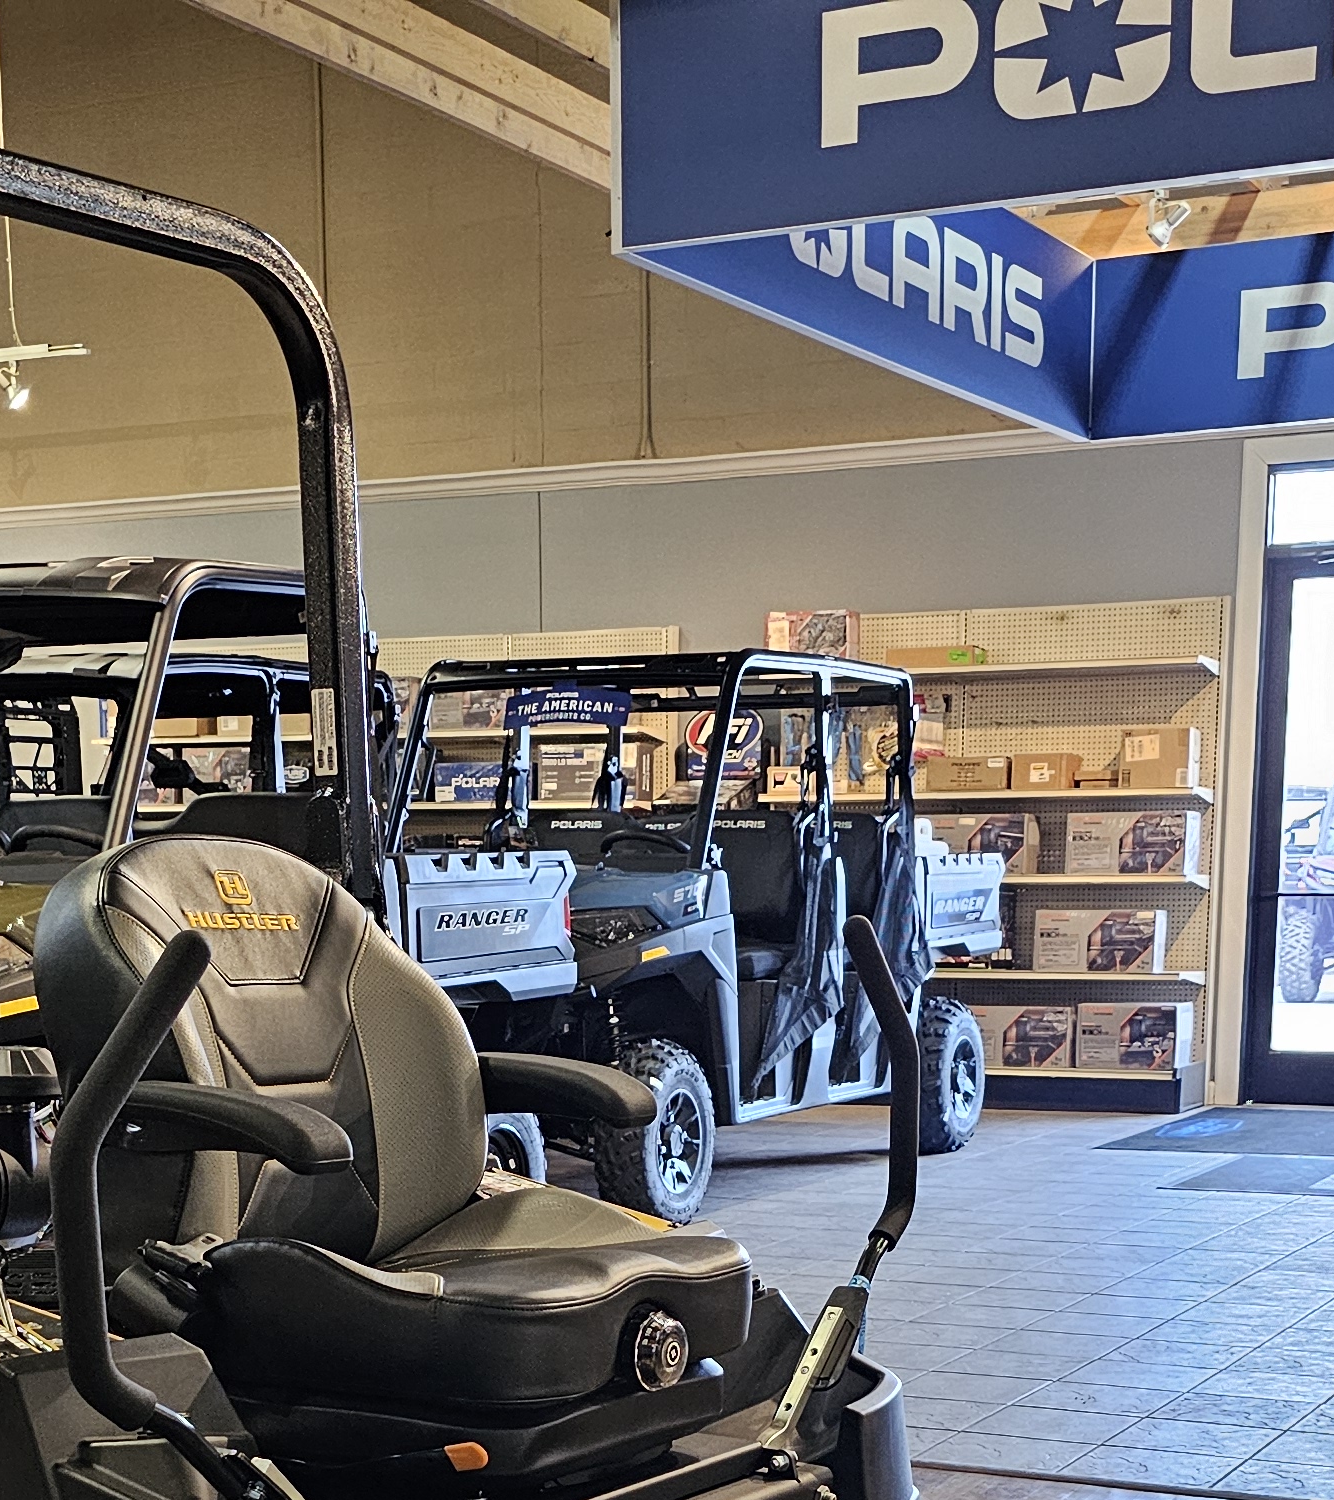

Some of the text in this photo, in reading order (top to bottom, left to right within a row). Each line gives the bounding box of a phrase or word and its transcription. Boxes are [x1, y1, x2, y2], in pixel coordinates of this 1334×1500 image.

[517, 699, 614, 716] THE AMERICAN
[550, 820, 603, 829] POLARIS
[713, 820, 766, 829] POLARIS
[186, 911, 301, 931] HUSTLER
[435, 908, 529, 931] RANGER
[502, 924, 530, 935] SP
